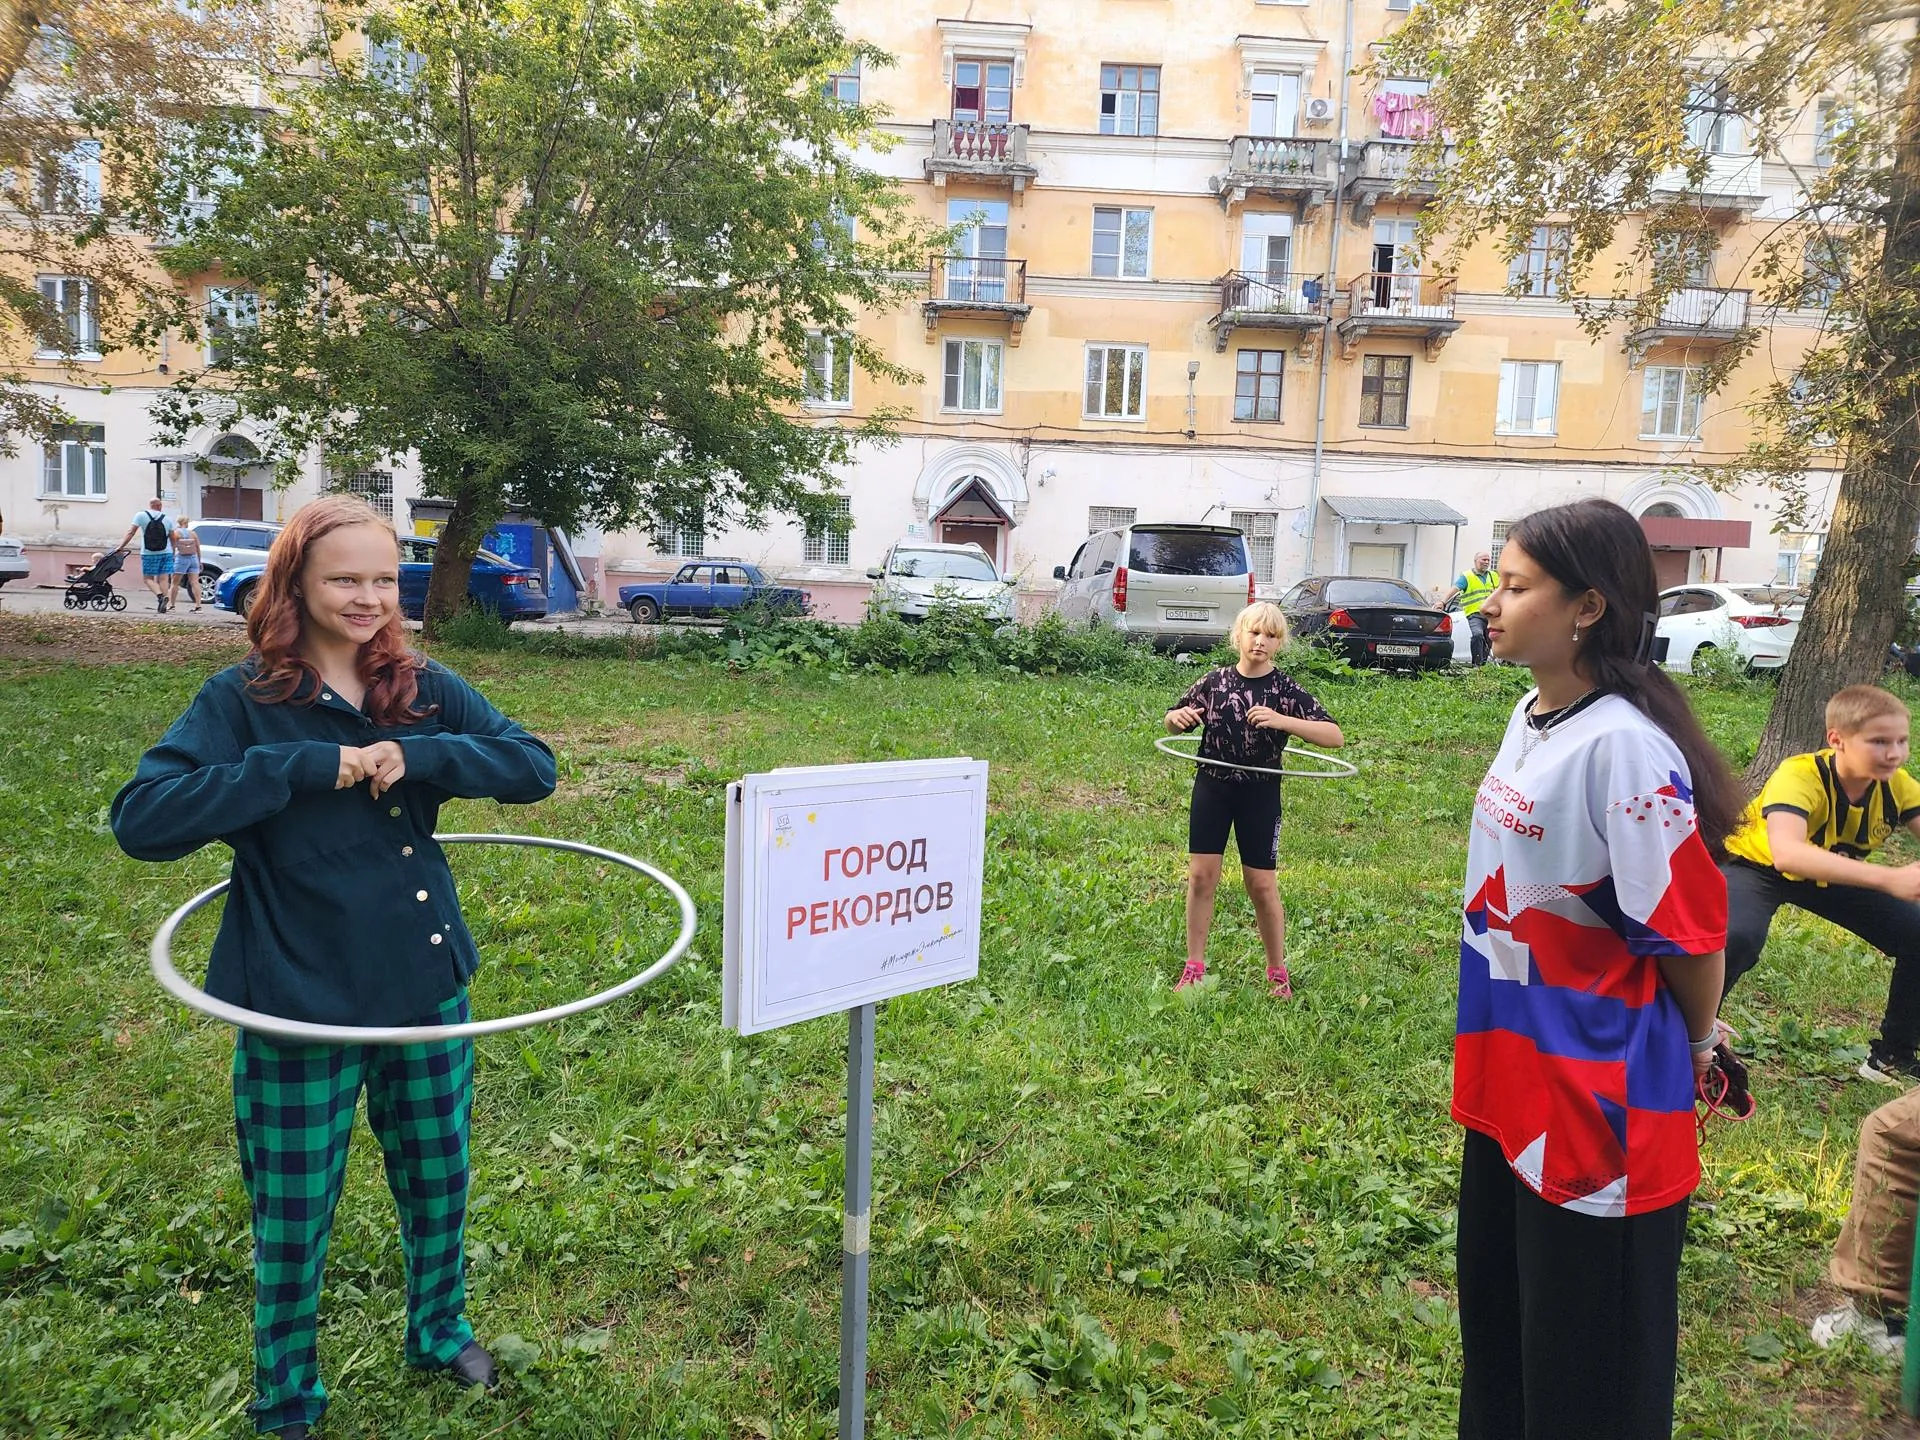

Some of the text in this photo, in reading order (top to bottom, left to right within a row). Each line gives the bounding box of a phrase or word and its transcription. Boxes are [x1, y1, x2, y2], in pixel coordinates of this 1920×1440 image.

[1475, 792, 1544, 841] МОСКОВЬЯ
[824, 838, 927, 881] ГОРОД
[787, 881, 954, 940] РЕКОРДОВ
